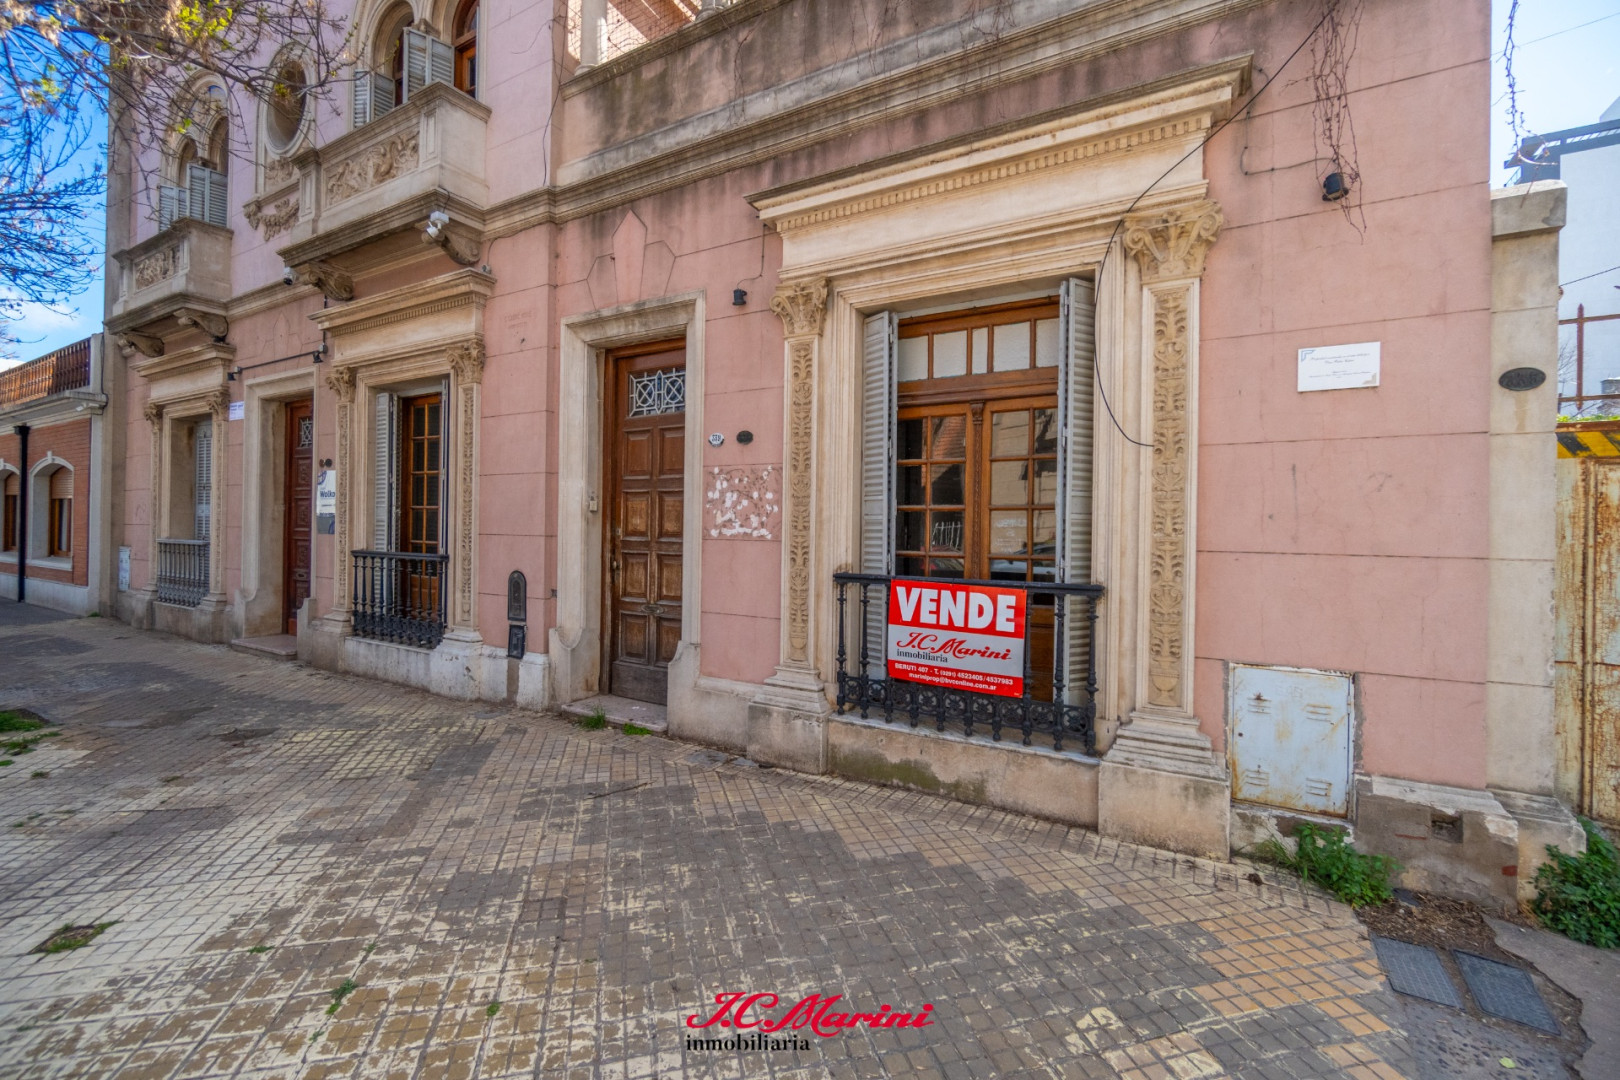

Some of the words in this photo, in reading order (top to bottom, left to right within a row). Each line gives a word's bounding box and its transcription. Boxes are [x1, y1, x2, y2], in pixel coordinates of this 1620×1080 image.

[896, 586, 1016, 632] VENDE
[897, 649, 948, 663] inmobiliaria
[894, 662, 917, 671] BERUTI
